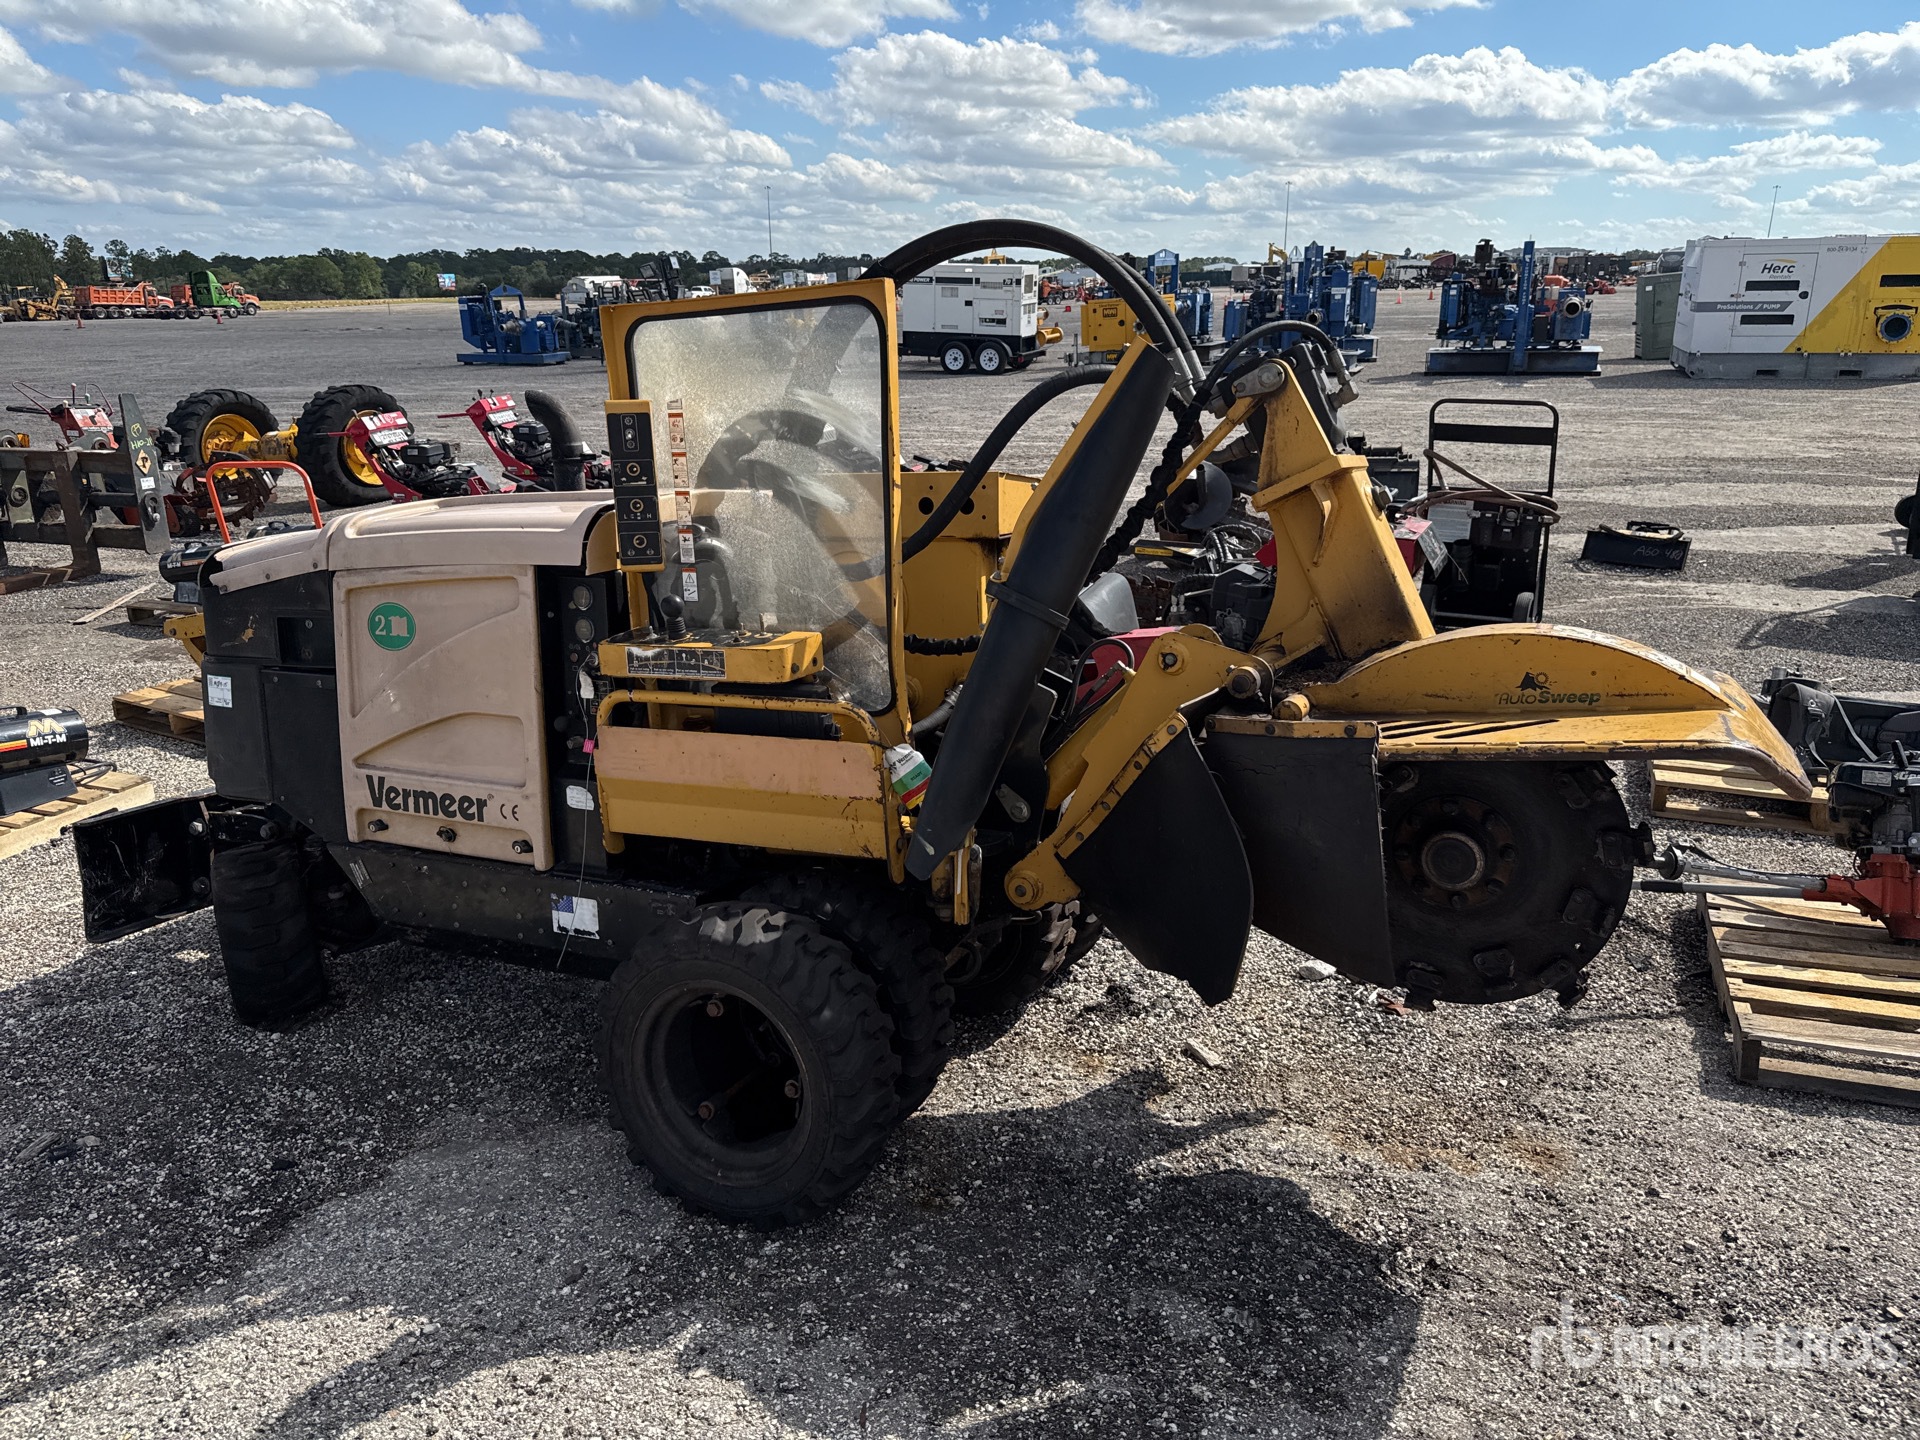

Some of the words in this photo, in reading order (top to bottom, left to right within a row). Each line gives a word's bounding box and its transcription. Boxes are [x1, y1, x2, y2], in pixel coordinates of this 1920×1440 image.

[1761, 263, 1796, 274] Herc
[1498, 690, 1602, 706] AutoSweep
[29, 733, 67, 748] Mi-T-M
[365, 774, 488, 823] Vermeer
